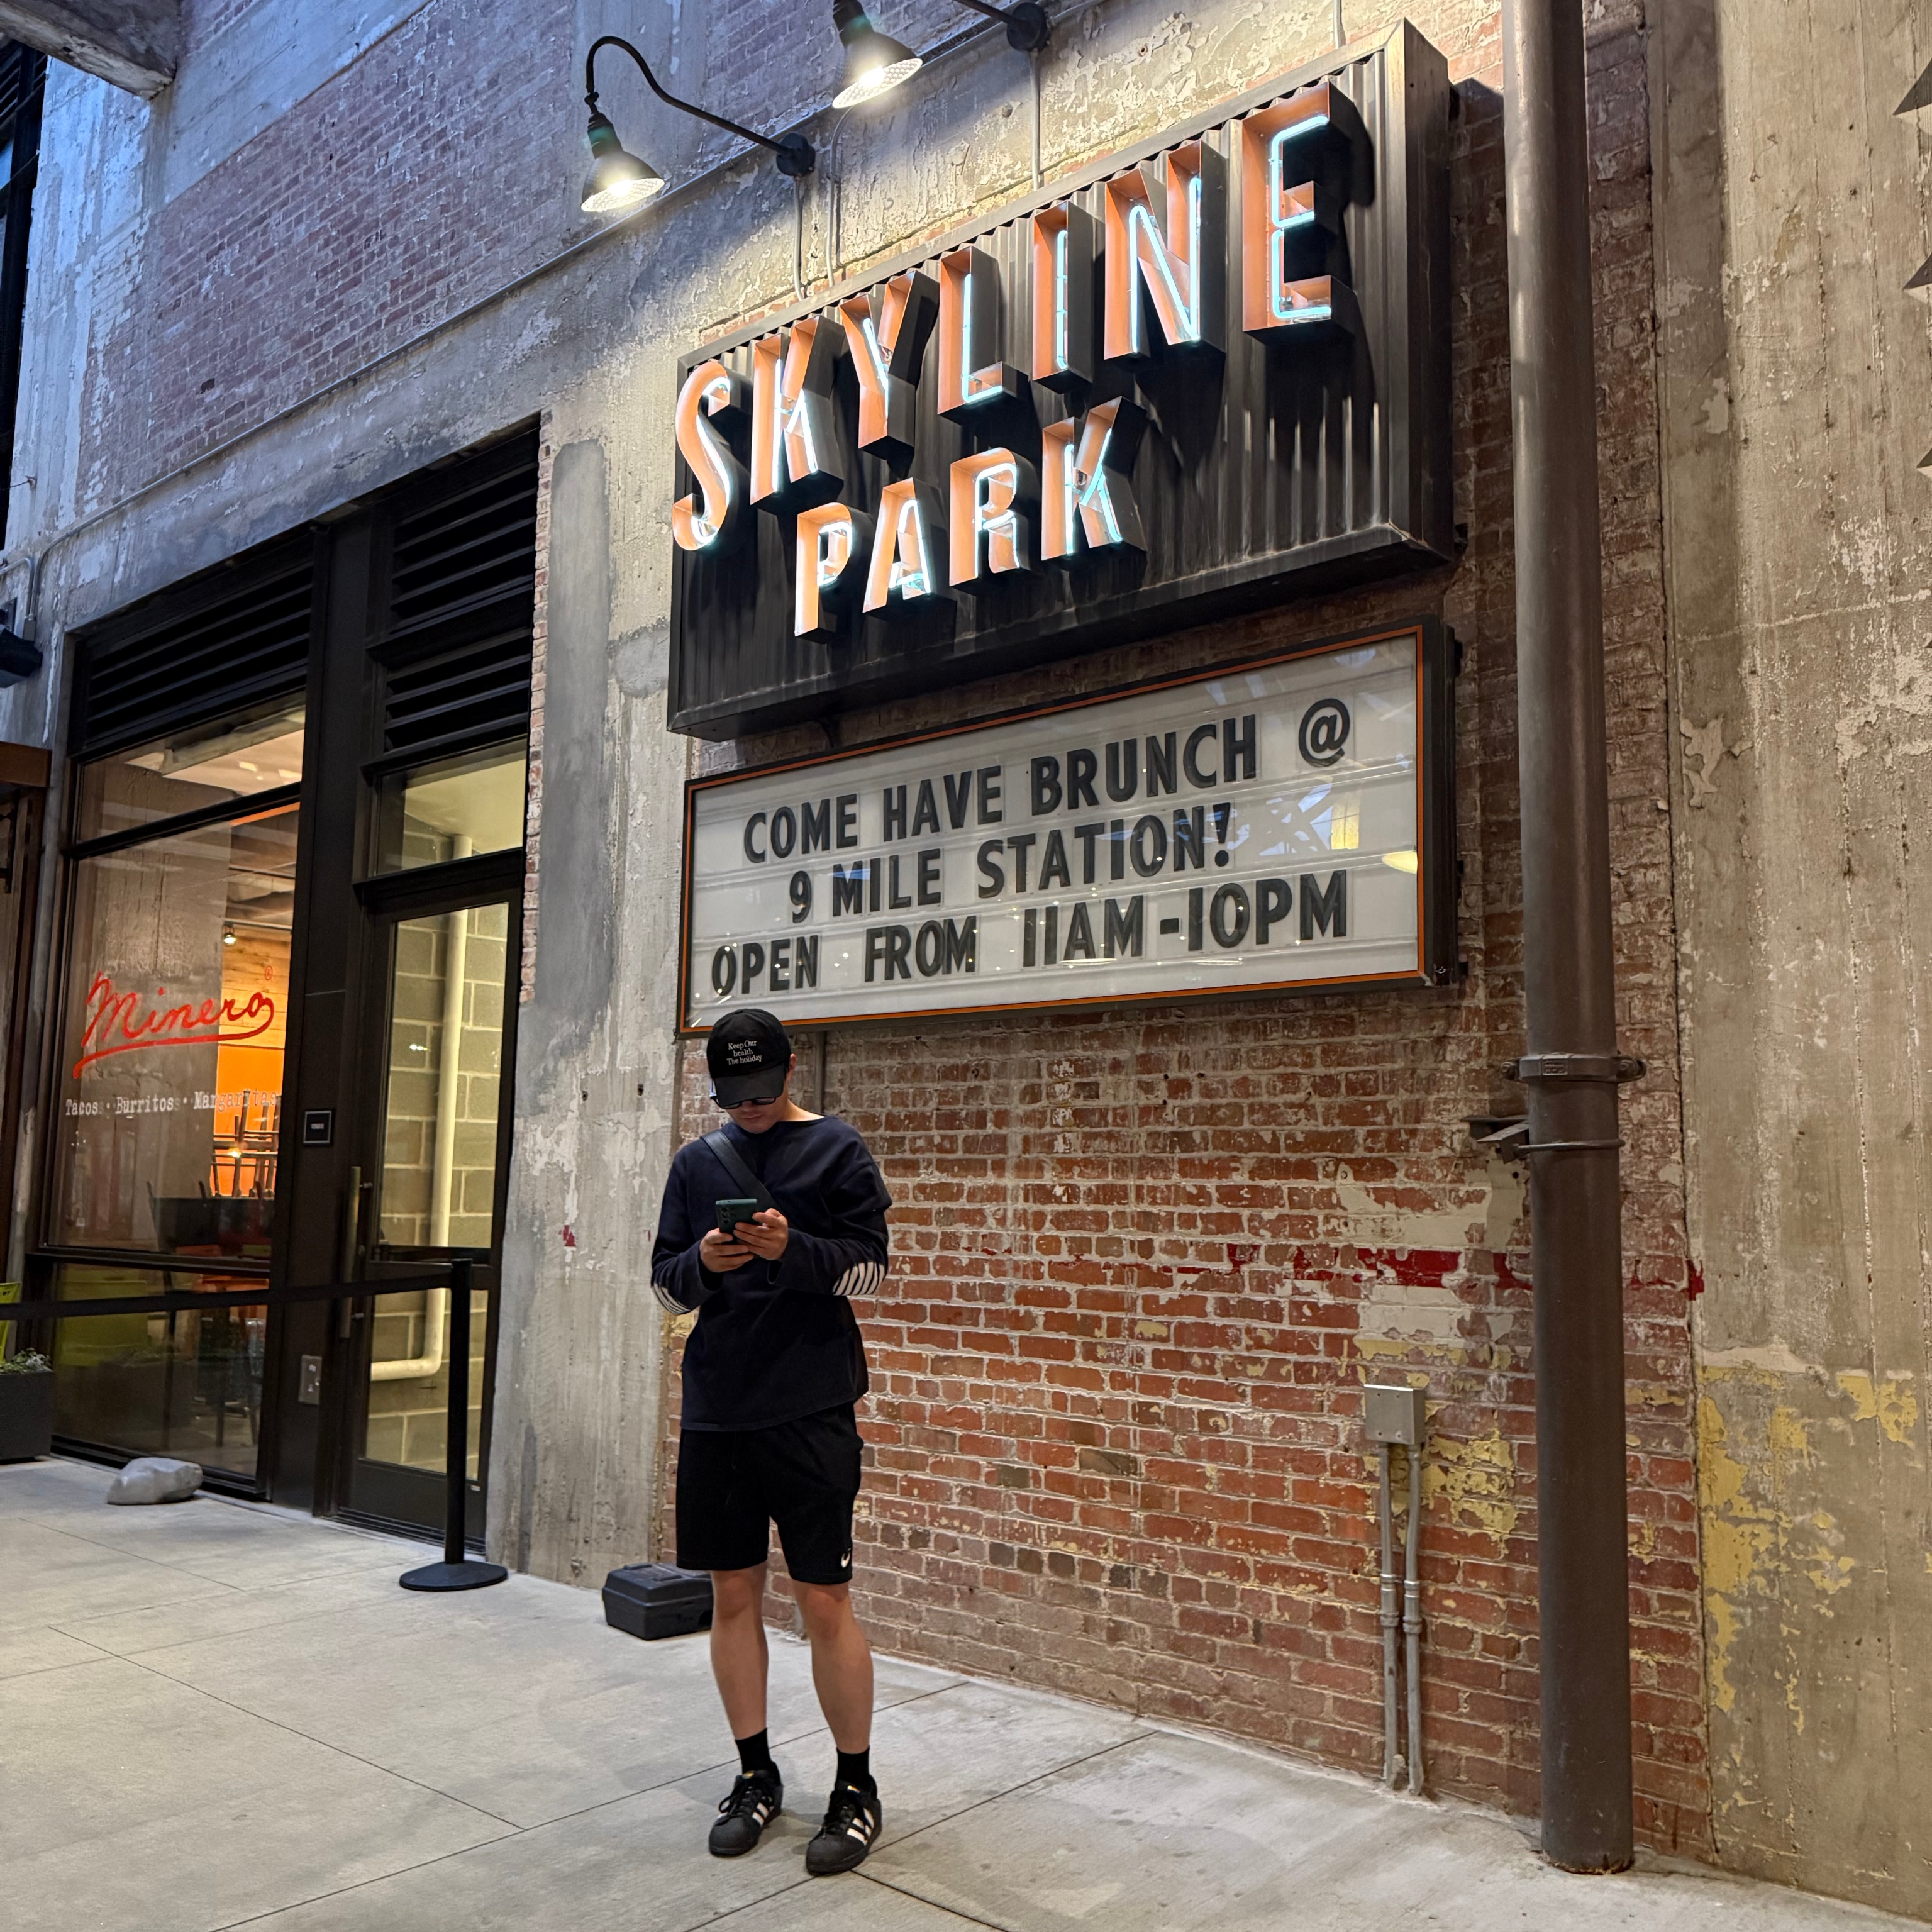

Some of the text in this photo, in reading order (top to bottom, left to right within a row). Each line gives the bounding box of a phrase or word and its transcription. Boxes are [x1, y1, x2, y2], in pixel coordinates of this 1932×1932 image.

[672, 82, 1332, 552] SKYLINE
[794, 396, 1126, 636] PARK
[744, 698, 1350, 863] COME HAVE BRUNCH @
[790, 802, 1231, 923] 9 MILE STATION!
[712, 935, 818, 996] OPEN
[865, 916, 977, 982] FROM
[73, 971, 274, 1079] Minero
[733, 1048, 753, 1057] health
[740, 1055, 762, 1063] holiday
[65, 1089, 277, 1116] Tacos Burritos Margaritas
